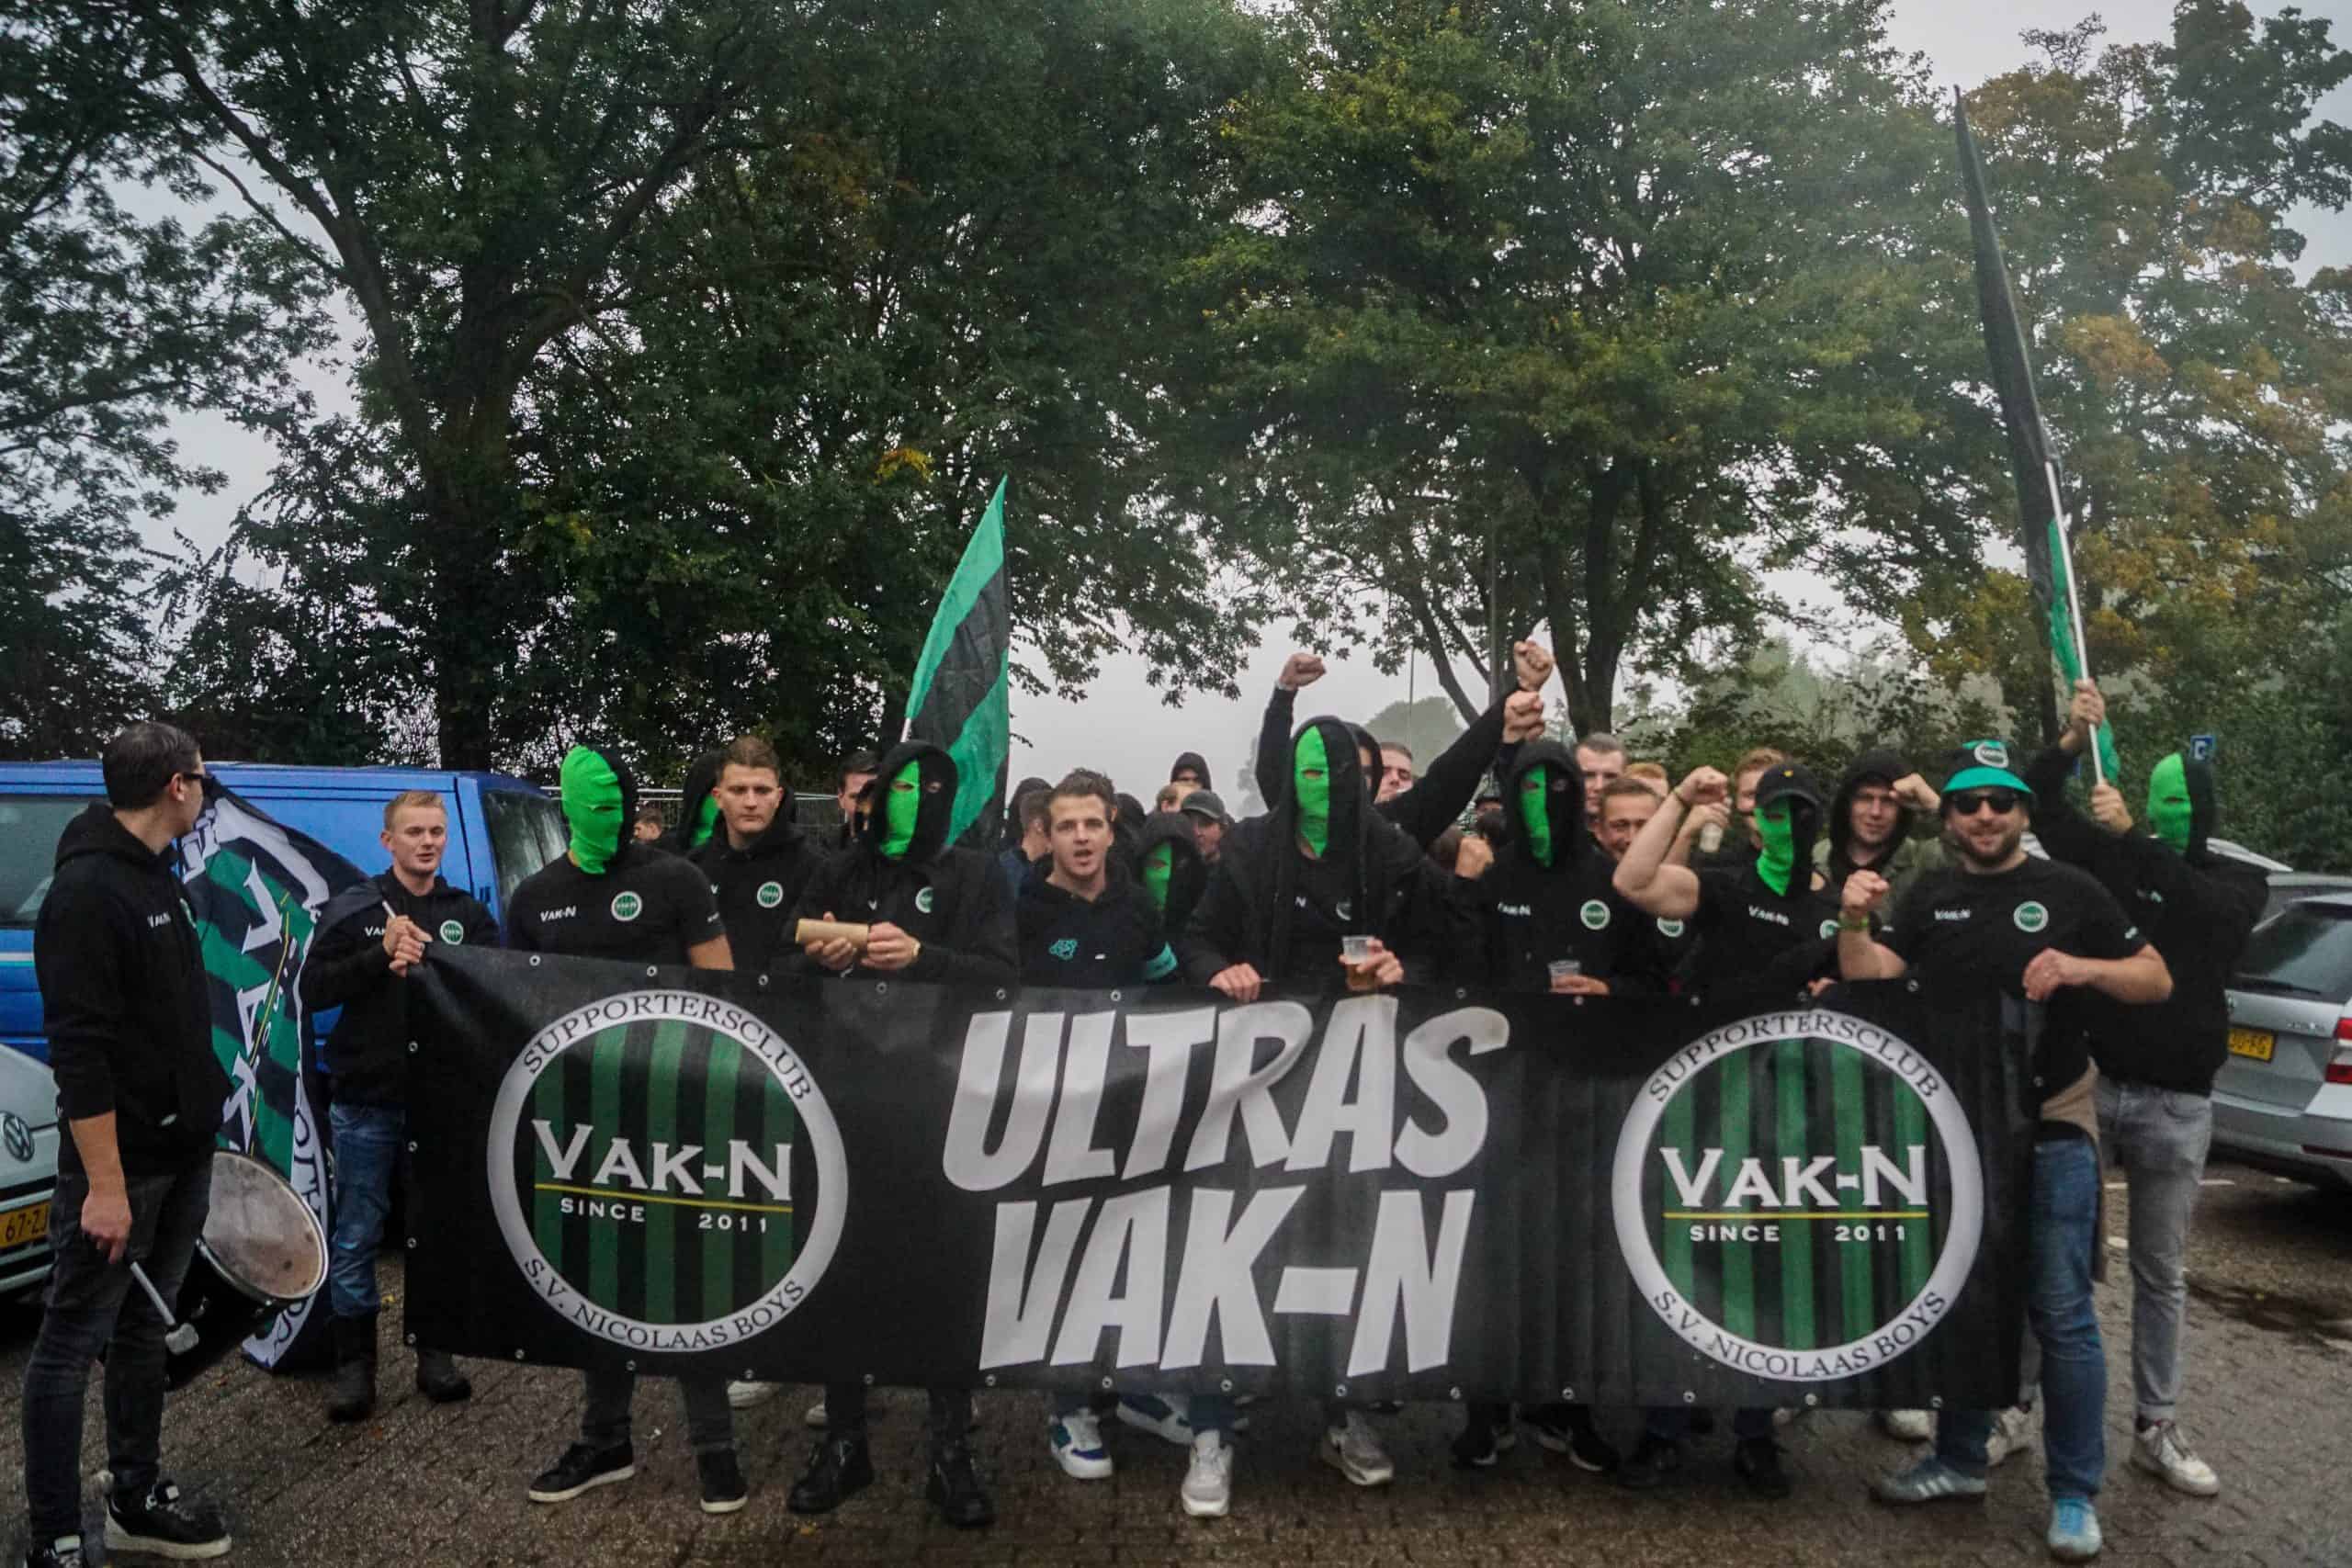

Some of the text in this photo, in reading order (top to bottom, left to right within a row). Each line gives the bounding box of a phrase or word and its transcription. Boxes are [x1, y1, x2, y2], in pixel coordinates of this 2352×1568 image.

[539, 905, 577, 922] VAK-N
[524, 993, 811, 1100] SUPPORTERSCLUB
[1649, 1013, 1939, 1102] SUPPORTERSCLUB
[943, 994, 1510, 1191] ULTRAS
[531, 1119, 793, 1201] VAK-N
[1659, 1145, 1928, 1208] VAK-N
[560, 1197, 768, 1234] SINCE 2011
[1690, 1224, 1906, 1243] SINCE 2011
[573, 1303, 729, 1351] NICOLAAS
[734, 1280, 806, 1337] BOYS
[978, 1184, 1476, 1377] VAK-N
[1706, 1332, 1871, 1378] NICOLAAS
[1874, 1291, 1946, 1359] BOYS
